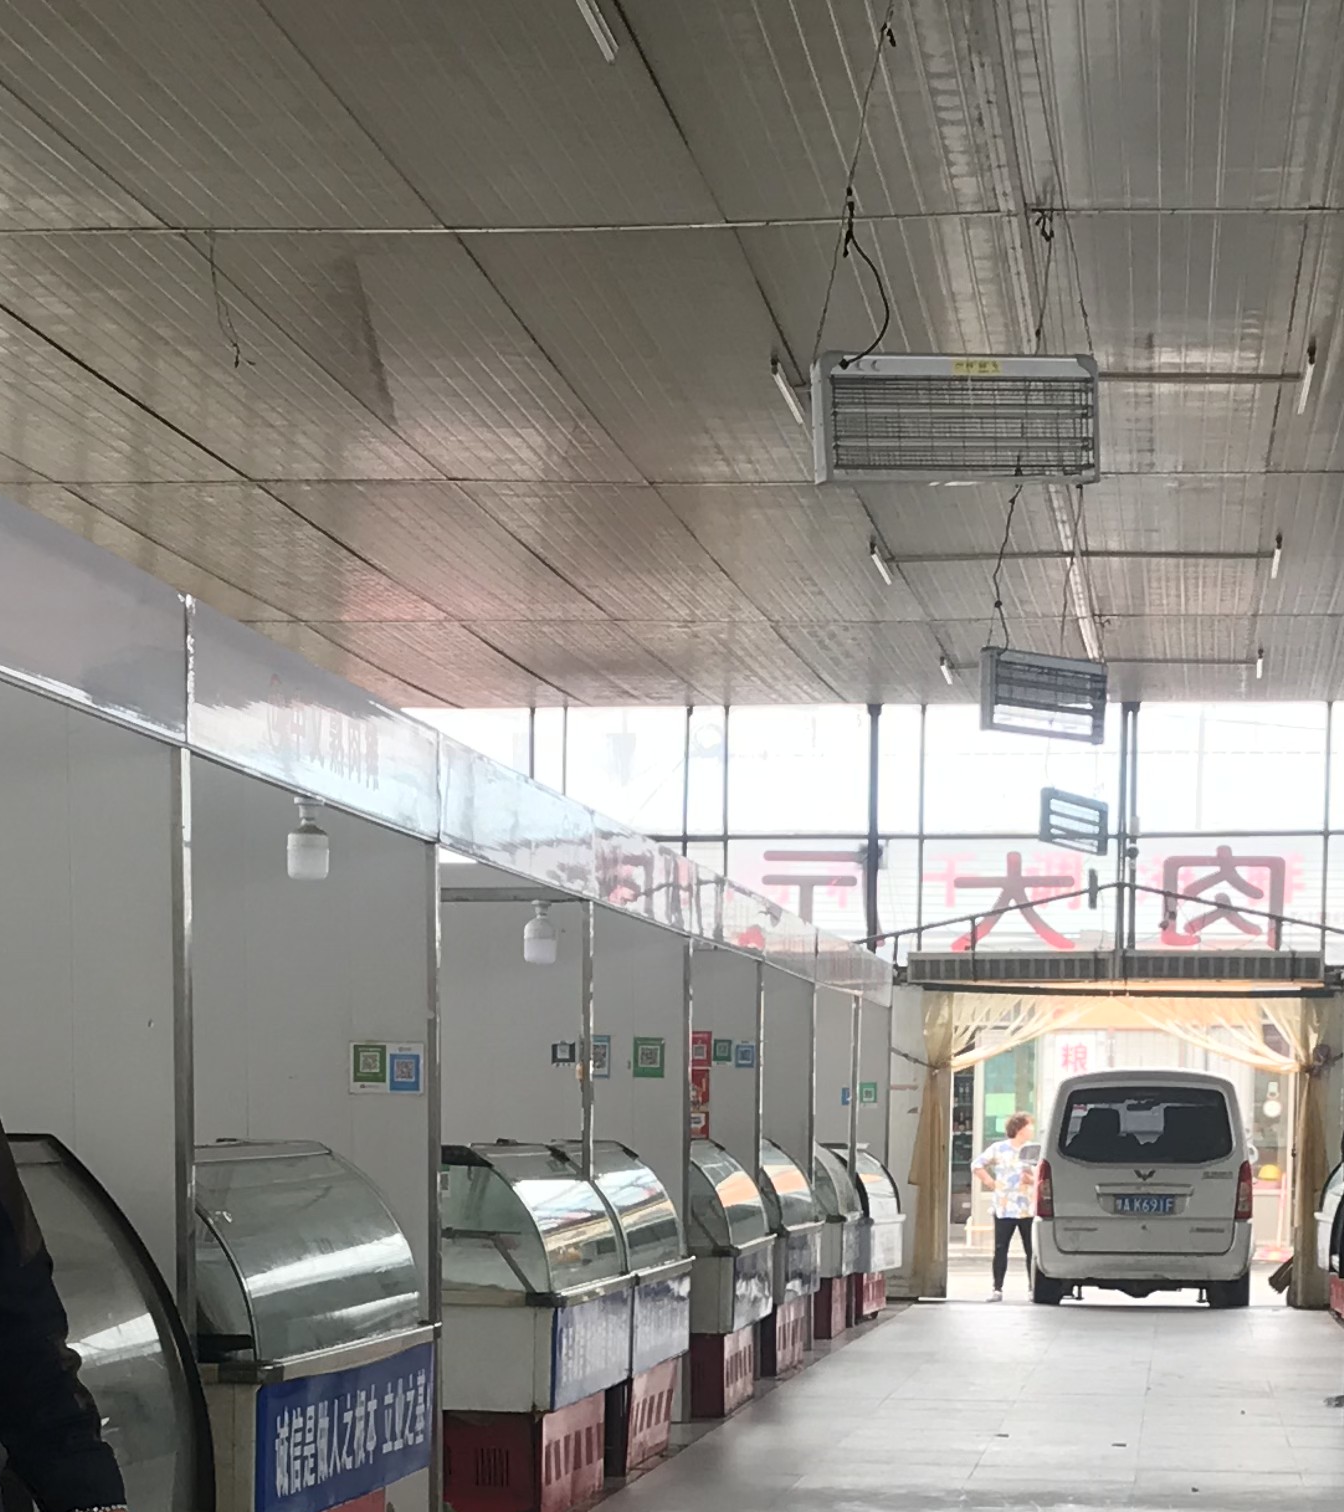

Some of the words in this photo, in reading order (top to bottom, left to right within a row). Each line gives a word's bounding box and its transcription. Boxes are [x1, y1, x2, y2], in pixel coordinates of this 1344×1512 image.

[275, 1384, 378, 1499] 诚信是做人之根本
